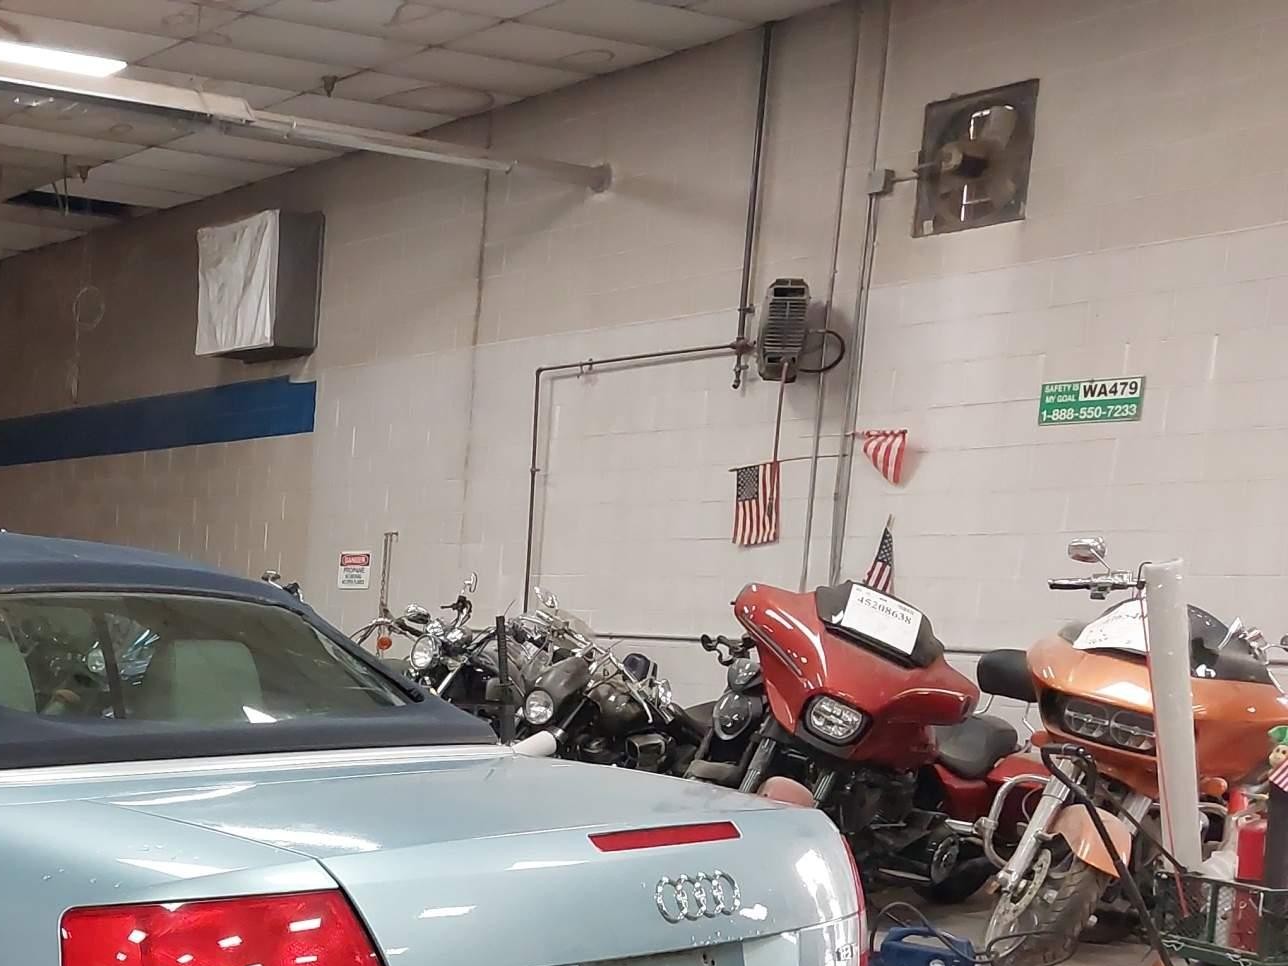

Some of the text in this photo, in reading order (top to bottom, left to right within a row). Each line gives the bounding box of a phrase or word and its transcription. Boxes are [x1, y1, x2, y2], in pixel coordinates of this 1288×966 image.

[1045, 384, 1072, 393] SAFETY
[1083, 381, 1138, 398] WA479
[1057, 394, 1077, 402] GOAL
[1041, 404, 1137, 421] 1-888-550-7233
[857, 596, 912, 625] 45208638
